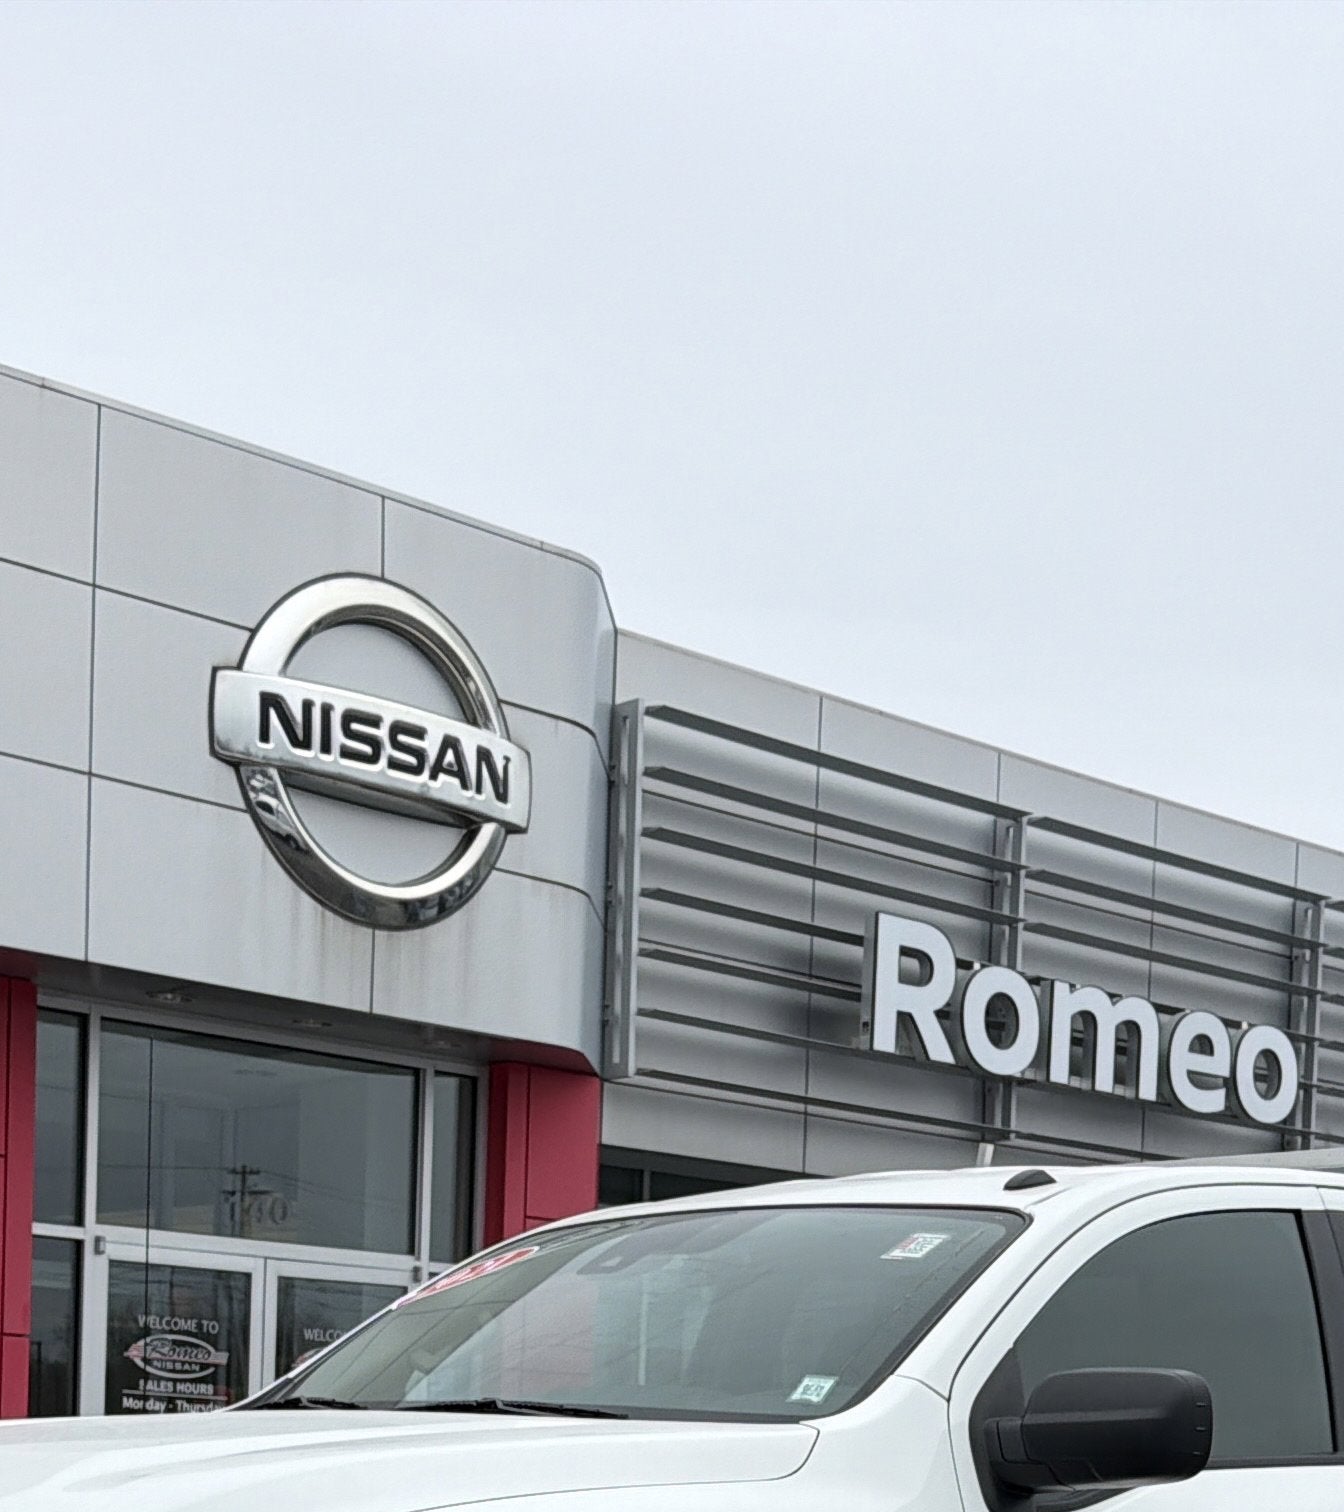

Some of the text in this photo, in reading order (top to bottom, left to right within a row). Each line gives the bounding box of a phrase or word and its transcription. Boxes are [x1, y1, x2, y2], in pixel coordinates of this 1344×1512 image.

[258, 690, 512, 806] NISSAN
[868, 911, 1299, 1124] Romeo
[138, 1314, 220, 1335] WELCOME TO
[152, 1360, 201, 1372] NISSAN
[176, 1382, 214, 1396] HOURS
